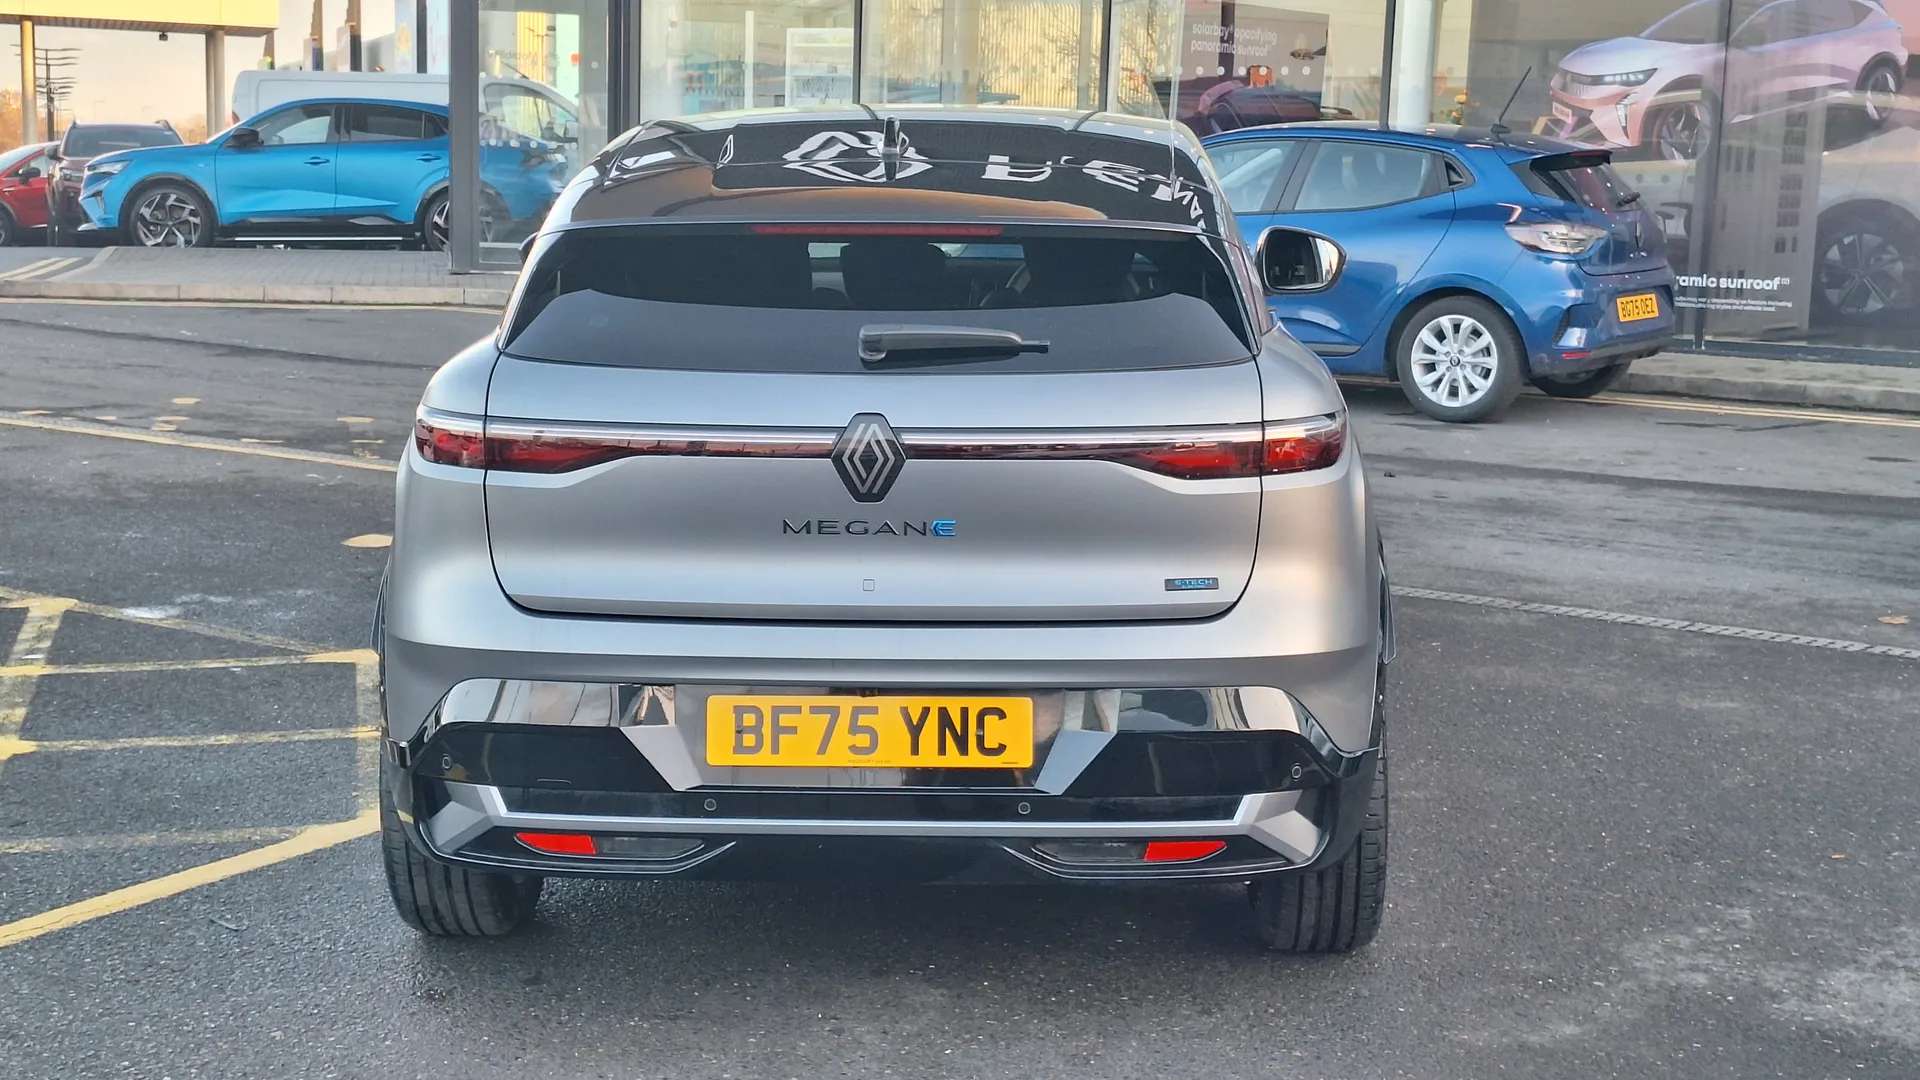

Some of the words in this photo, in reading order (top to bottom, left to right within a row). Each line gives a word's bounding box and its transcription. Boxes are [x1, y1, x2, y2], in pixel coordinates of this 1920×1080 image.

[782, 518, 957, 537] MEGANE
[731, 704, 880, 756] BF75
[900, 705, 1008, 757] YNC
